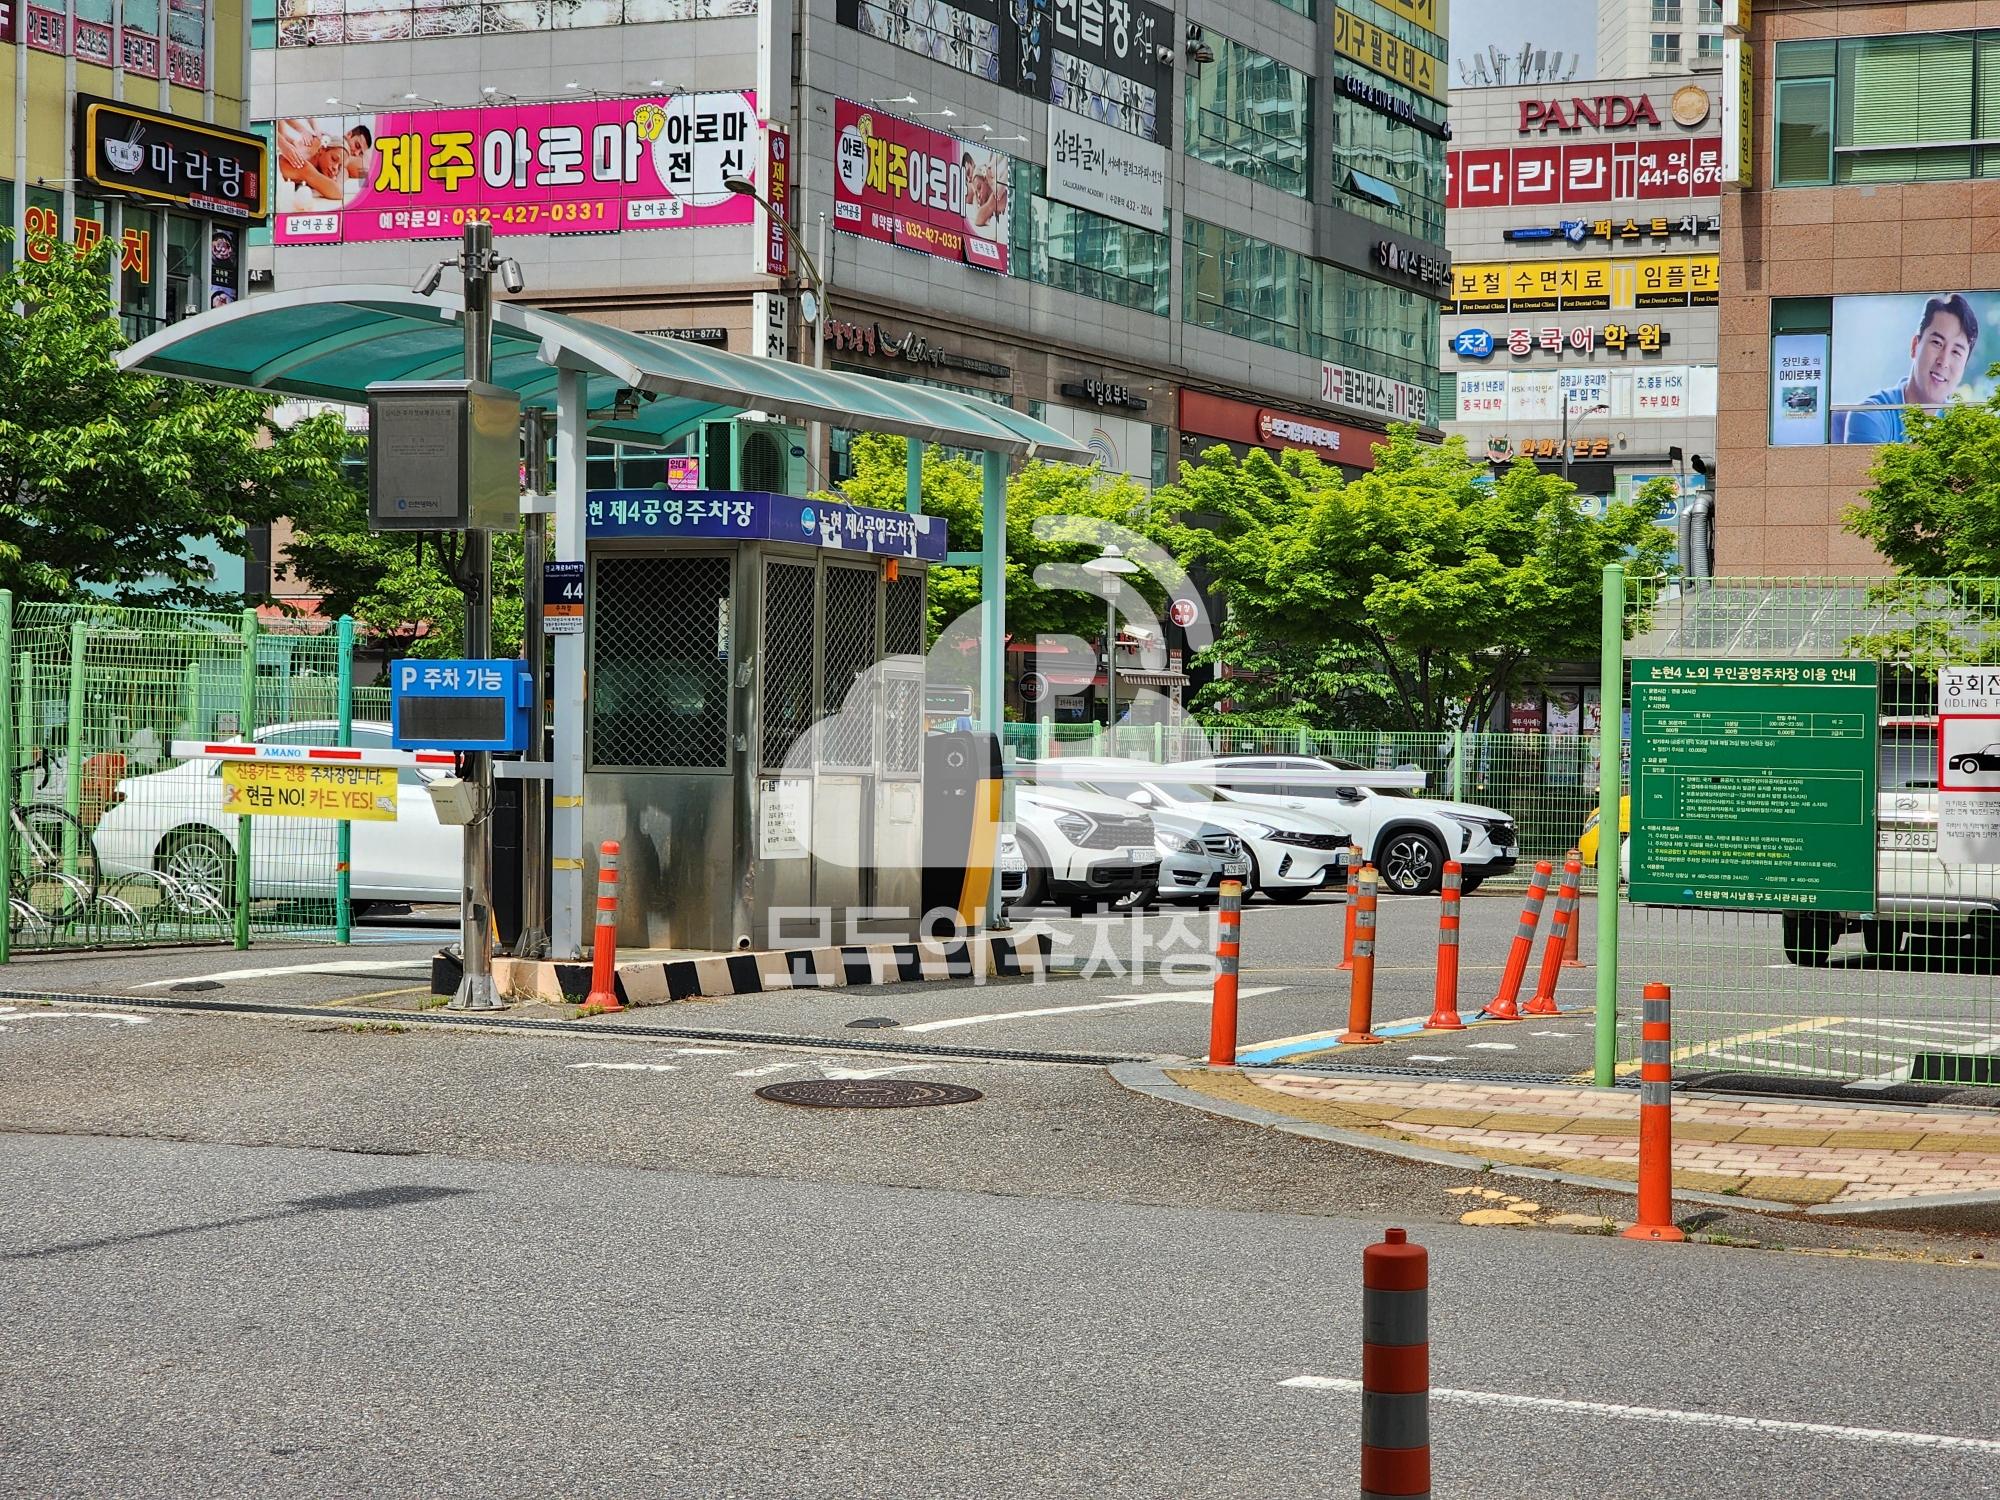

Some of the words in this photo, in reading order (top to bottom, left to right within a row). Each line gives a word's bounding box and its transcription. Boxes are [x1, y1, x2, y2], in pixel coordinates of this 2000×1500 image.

[28, 11, 64, 48] 아로마
[1347, 75, 1366, 98] CAFE
[1368, 89, 1373, 101] &
[1376, 90, 1391, 111] LIVE
[1394, 98, 1416, 121] MUSIC
[1518, 94, 1661, 132] PANDA
[667, 112, 748, 145] 아로마
[151, 144, 244, 198] 마라탕
[452, 202, 604, 225] 032-427-0331
[631, 201, 681, 217] 남여공용
[836, 203, 861, 219] 남여공용
[290, 216, 336, 234] 남여공용
[906, 222, 962, 250] 032-427-0331
[250, 270, 263, 280] 4F
[1460, 272, 1500, 294] 보철
[1514, 269, 1603, 293] 수면치료
[1459, 332, 1489, 352] 天才
[1665, 376, 1682, 387] HSK
[1640, 396, 1680, 407] 주부회화
[670, 460, 687, 469] 임대
[586, 501, 603, 526] 현
[609, 499, 754, 527] 제4공영주차장
[563, 582, 584, 600] 44
[402, 667, 417, 691] P
[423, 667, 460, 690] 주차
[466, 667, 503, 691] 가능
[1651, 666, 1682, 679] 논현4
[1685, 666, 1709, 680] 노외
[1713, 667, 1799, 681] 무인공영주차장
[1802, 668, 1828, 681] 이용
[1831, 668, 1856, 681] 안내
[1944, 698, 1987, 708] (IDLING
[264, 748, 302, 758] AMANO
[236, 763, 281, 781] 신용카드
[285, 765, 306, 782] 전용
[310, 767, 383, 785] 주차장입니다.
[246, 785, 274, 807] 현금
[279, 788, 304, 806] NO!
[310, 788, 339, 809] 카드
[342, 791, 373, 810] YES!
[1896, 833, 1929, 846] 9285
